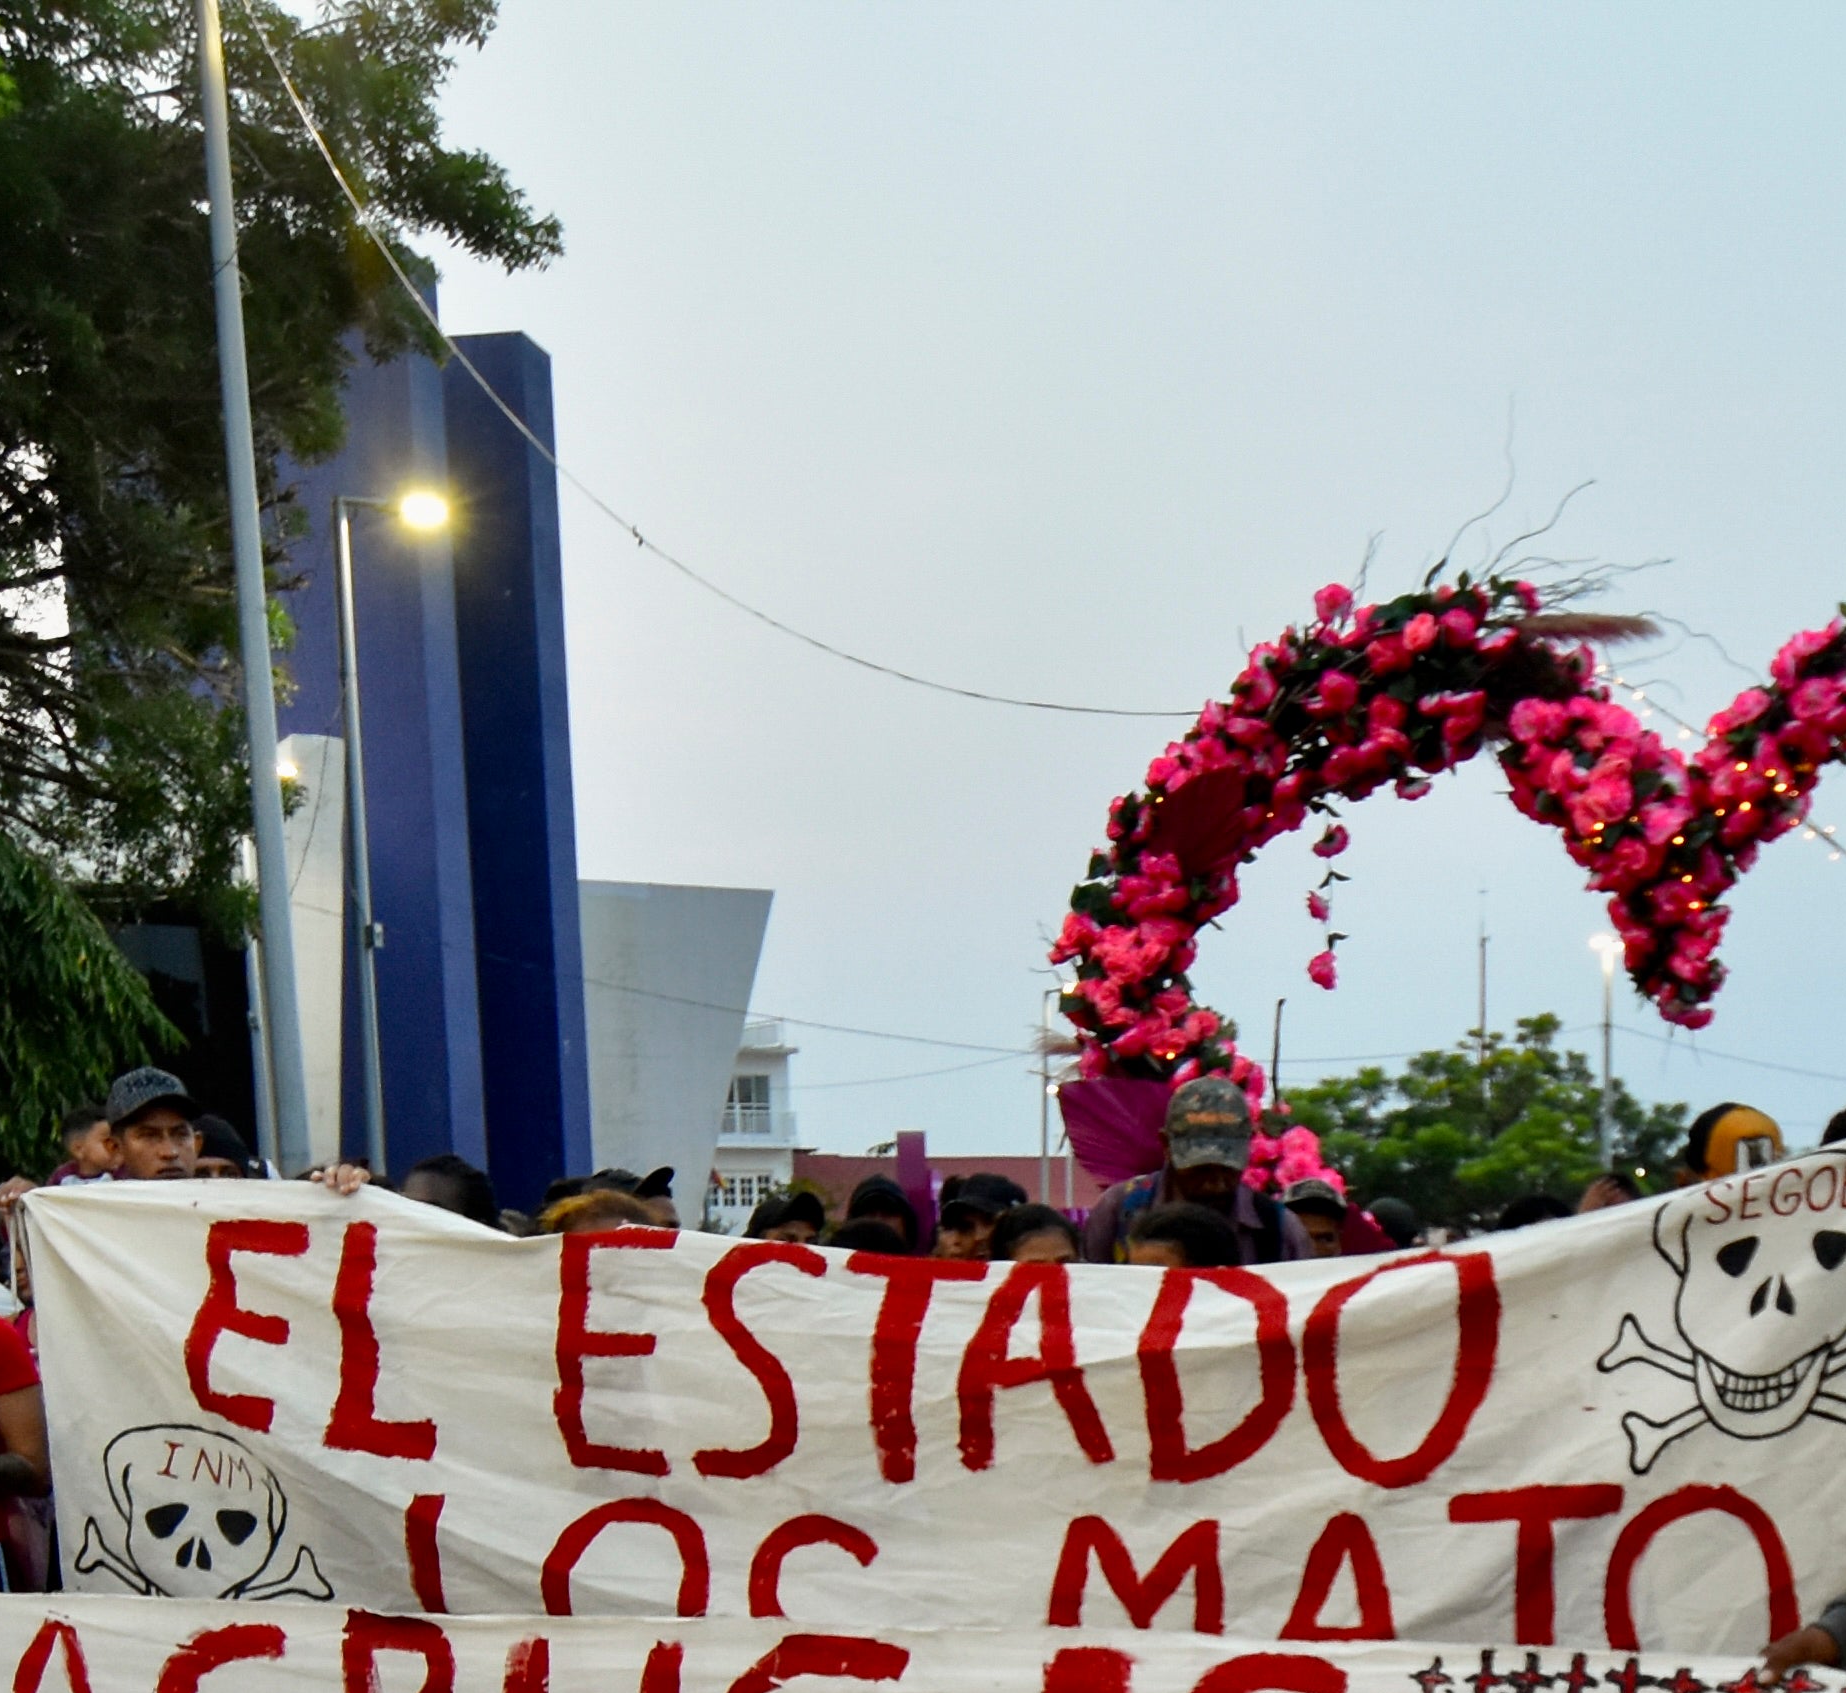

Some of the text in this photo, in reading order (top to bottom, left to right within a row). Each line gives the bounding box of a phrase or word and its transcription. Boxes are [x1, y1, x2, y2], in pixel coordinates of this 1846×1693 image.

[183, 1218, 1502, 1489] EL ESTADO
[156, 1439, 253, 1492] INM
